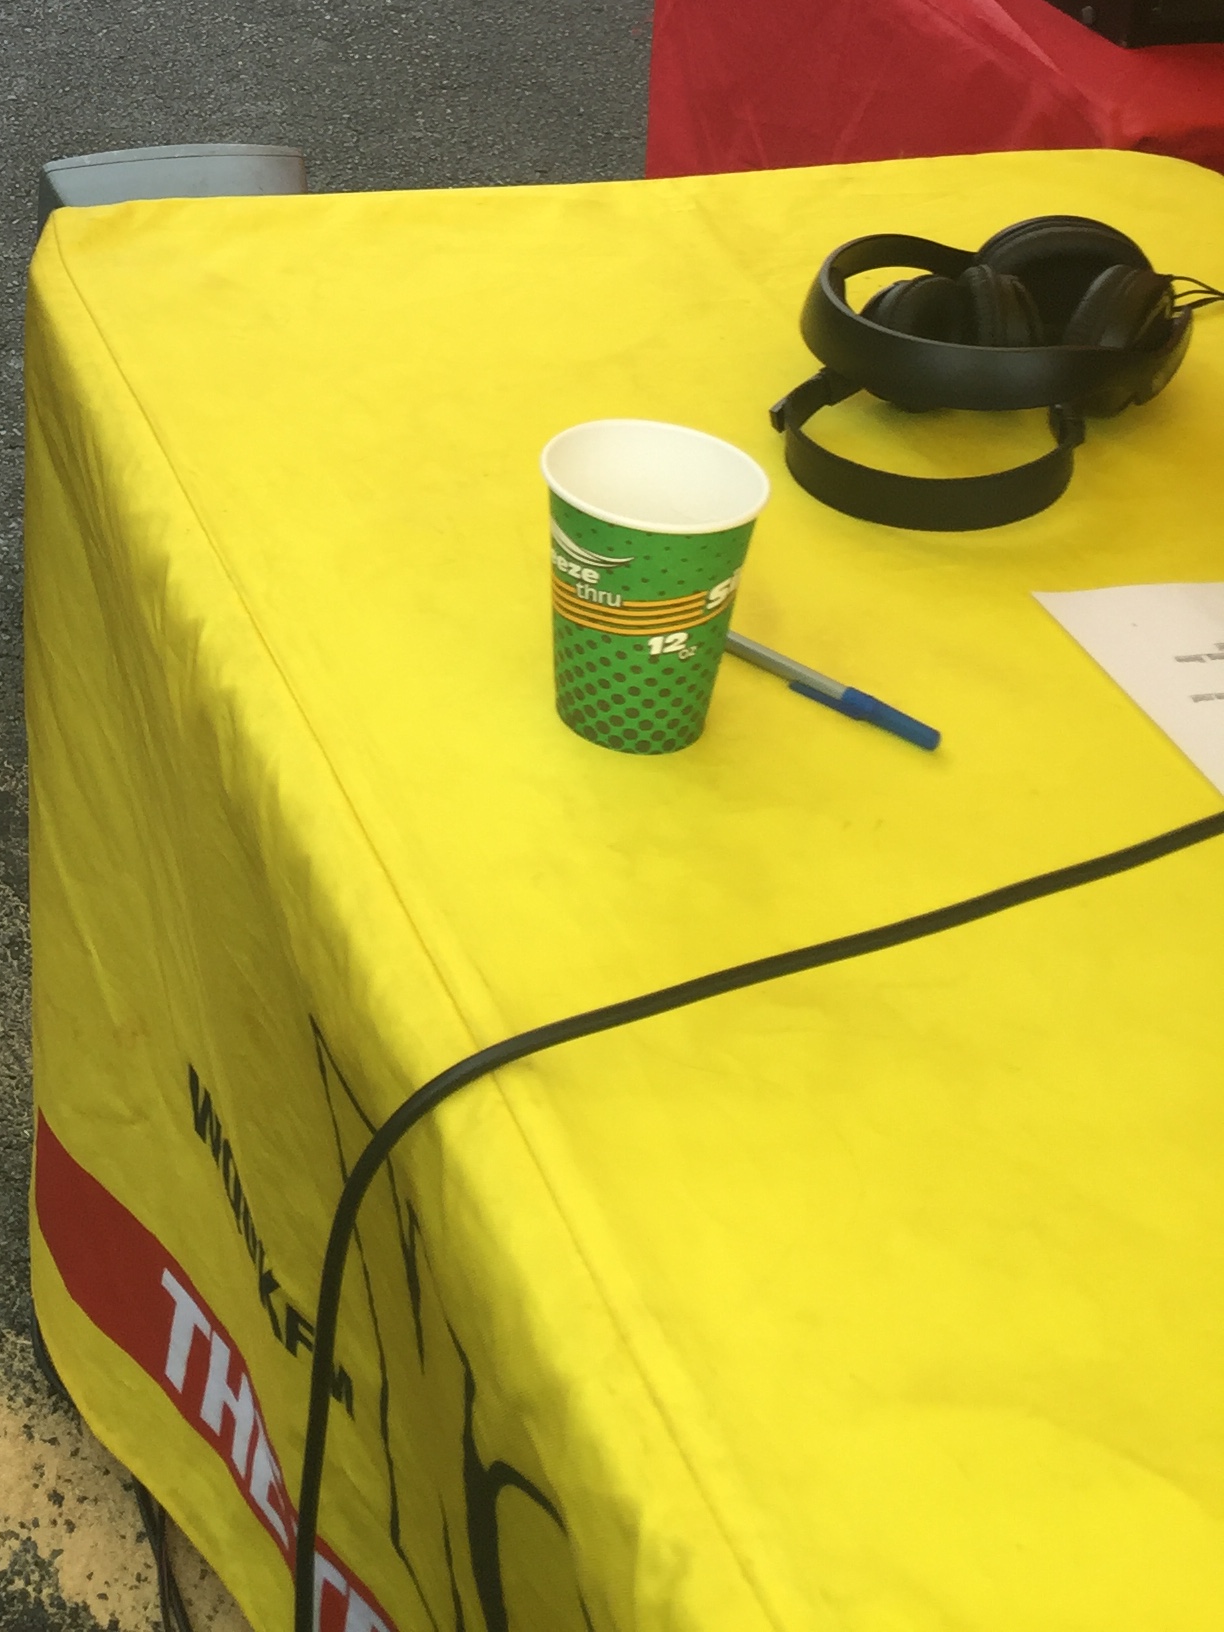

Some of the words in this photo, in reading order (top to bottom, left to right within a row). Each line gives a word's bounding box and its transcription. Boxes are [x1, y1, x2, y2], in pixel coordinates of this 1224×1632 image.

[576, 581, 622, 608] thru
[648, 632, 689, 656] 12
[678, 645, 697, 660] oz
[161, 1267, 290, 1552] THE
